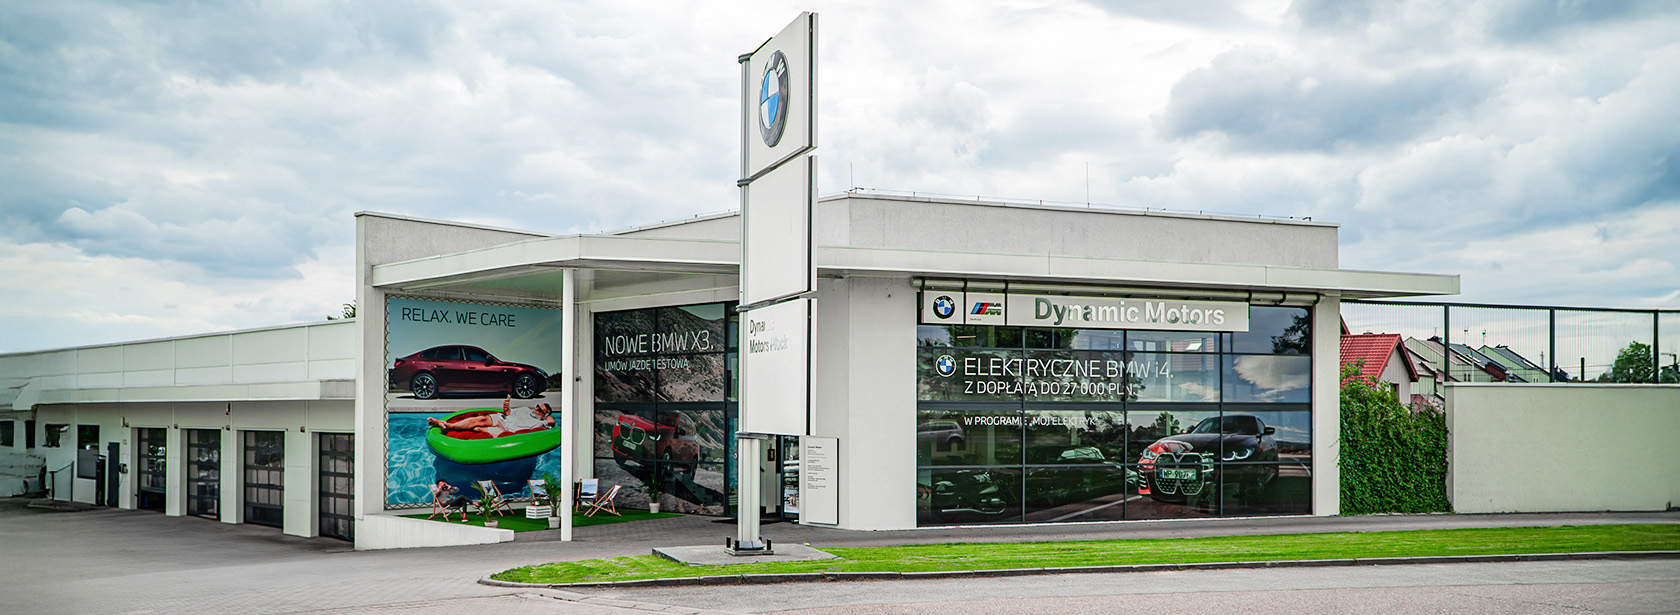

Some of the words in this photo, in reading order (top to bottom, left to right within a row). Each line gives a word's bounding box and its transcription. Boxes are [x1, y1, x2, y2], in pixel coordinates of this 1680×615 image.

[402, 307, 452, 324] RELAX.
[455, 311, 478, 325] WE
[480, 312, 516, 328] CARE
[1034, 297, 1140, 326] Dynamic
[1145, 301, 1226, 325] Motors
[750, 319, 775, 337] Dyna
[605, 334, 648, 355] NOWE
[651, 331, 689, 353] BMW
[690, 329, 715, 351] X3.
[750, 339, 770, 354] Motors
[604, 359, 629, 372] UMÓW
[964, 357, 1101, 378] ELEKTRYCZNE
[1106, 360, 1151, 378] BMW
[1154, 361, 1174, 379] i4.
[964, 380, 974, 394] Z
[977, 380, 1038, 397] DOPŁATĄ
[1040, 382, 1060, 395] DO
[1062, 382, 1078, 395] 27
[1080, 382, 1105, 395] 000
[1108, 383, 1136, 396] PLN.
[964, 416, 973, 426] W
[974, 416, 1028, 426] PROGRAMIE
